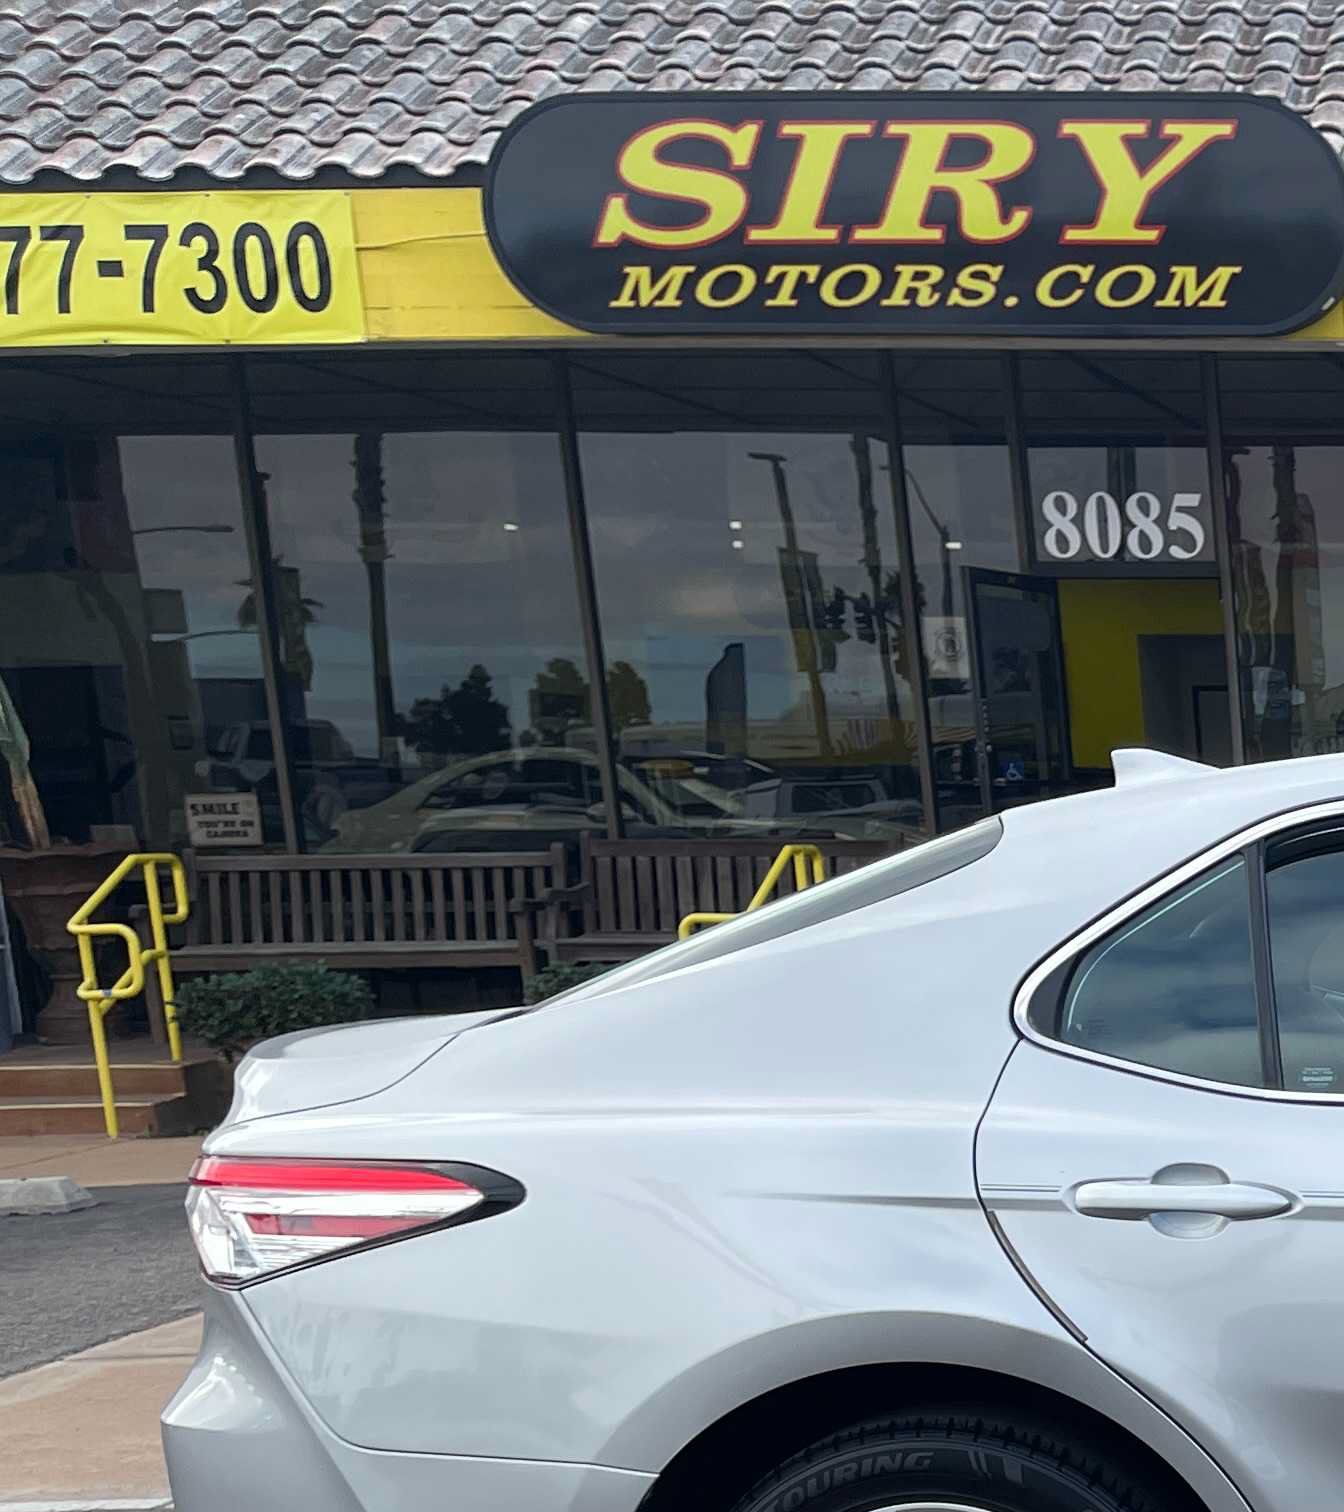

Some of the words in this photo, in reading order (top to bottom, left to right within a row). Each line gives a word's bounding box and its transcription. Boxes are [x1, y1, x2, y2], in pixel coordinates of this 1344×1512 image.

[592, 118, 1238, 248] SIRY
[0, 221, 332, 315] 77-7300
[608, 263, 1242, 308] MOTORS.COM
[1041, 490, 1205, 560] 8085
